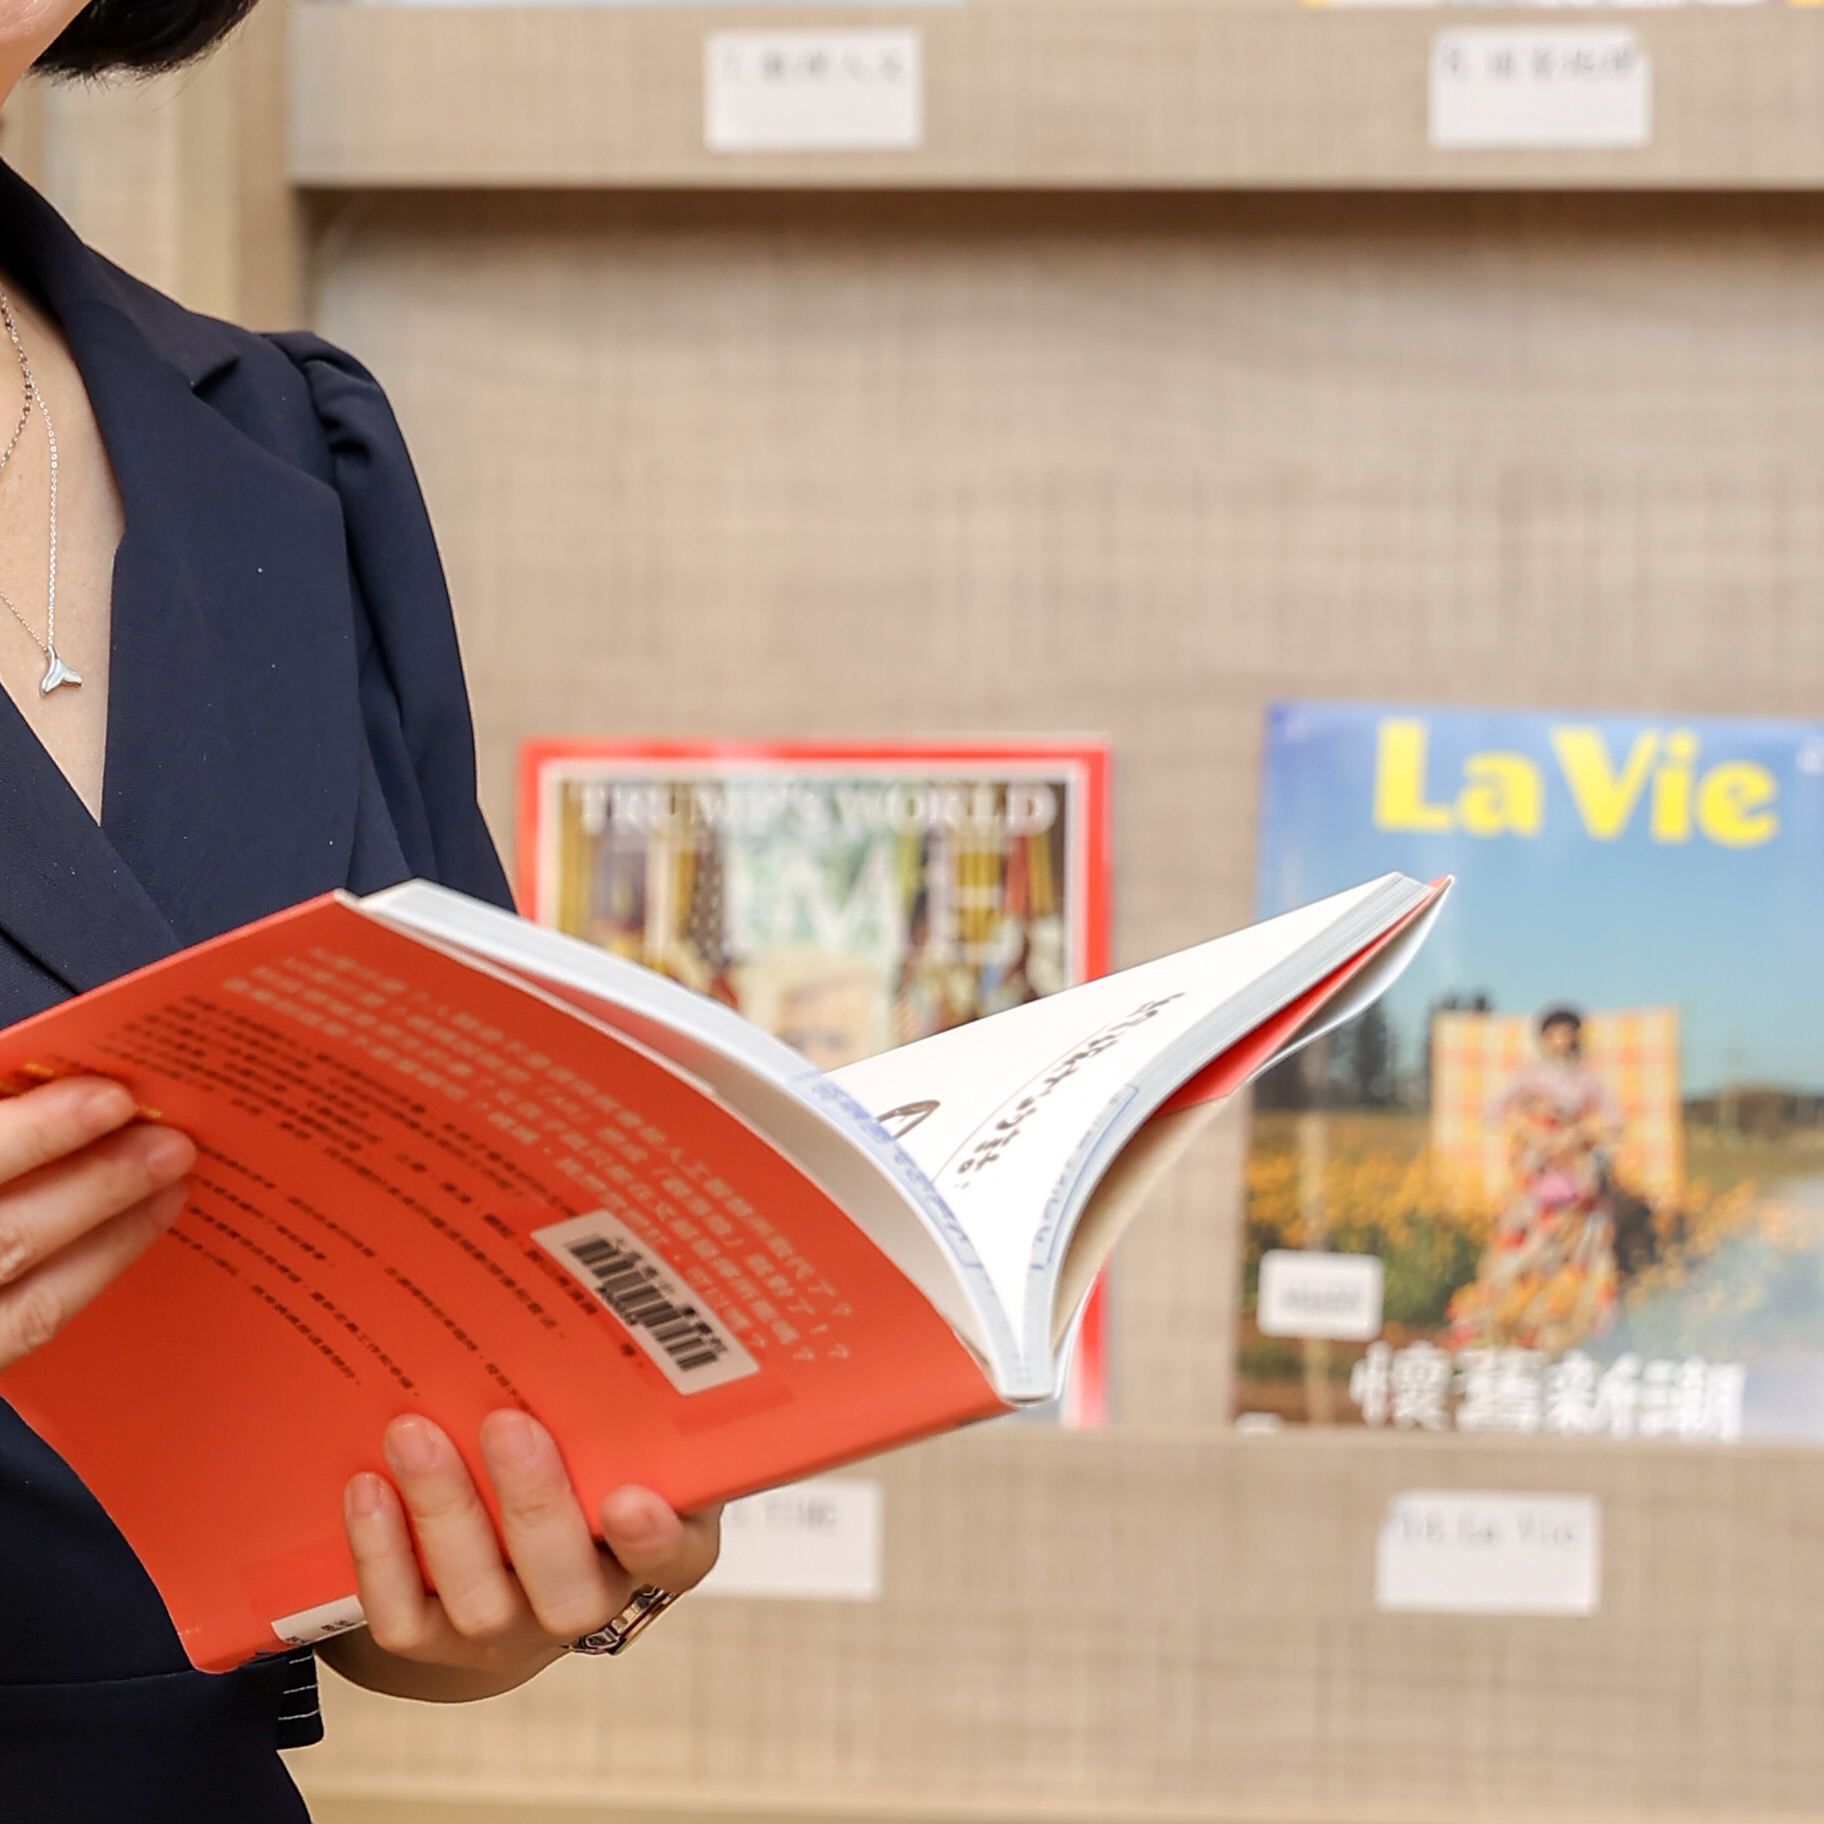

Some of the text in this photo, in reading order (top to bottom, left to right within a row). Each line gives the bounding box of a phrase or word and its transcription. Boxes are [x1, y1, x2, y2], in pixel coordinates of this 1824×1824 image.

[833, 779, 1059, 840] WORLD
[1348, 1339, 1747, 1443] 懷舊新潮
